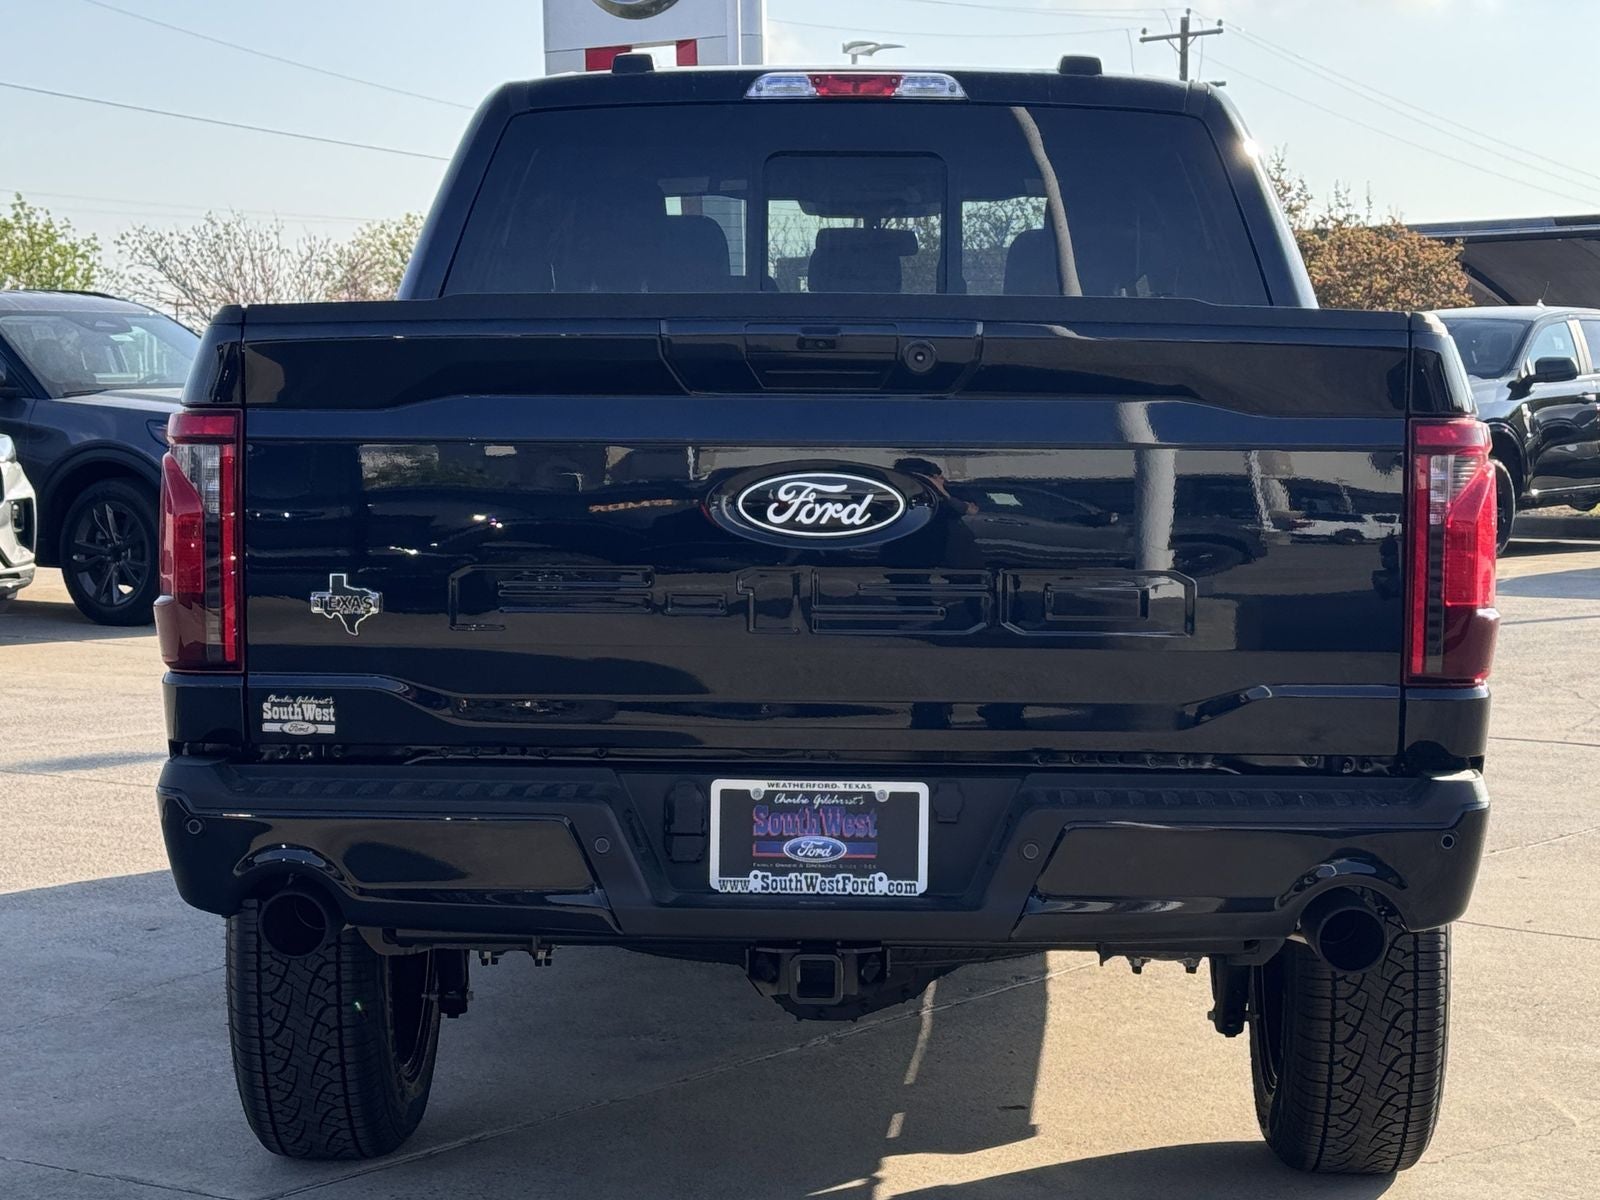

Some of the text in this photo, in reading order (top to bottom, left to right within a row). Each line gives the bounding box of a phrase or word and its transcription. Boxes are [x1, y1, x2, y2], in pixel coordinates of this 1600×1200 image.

[767, 481, 874, 526] Ford
[315, 595, 374, 610] TEXAS
[449, 565, 1198, 637] F-150
[262, 702, 335, 722] SouthWest
[288, 723, 310, 732] Ford
[774, 793, 809, 805] Charlie
[752, 804, 878, 838] SouthWest
[797, 840, 832, 858] Ford
